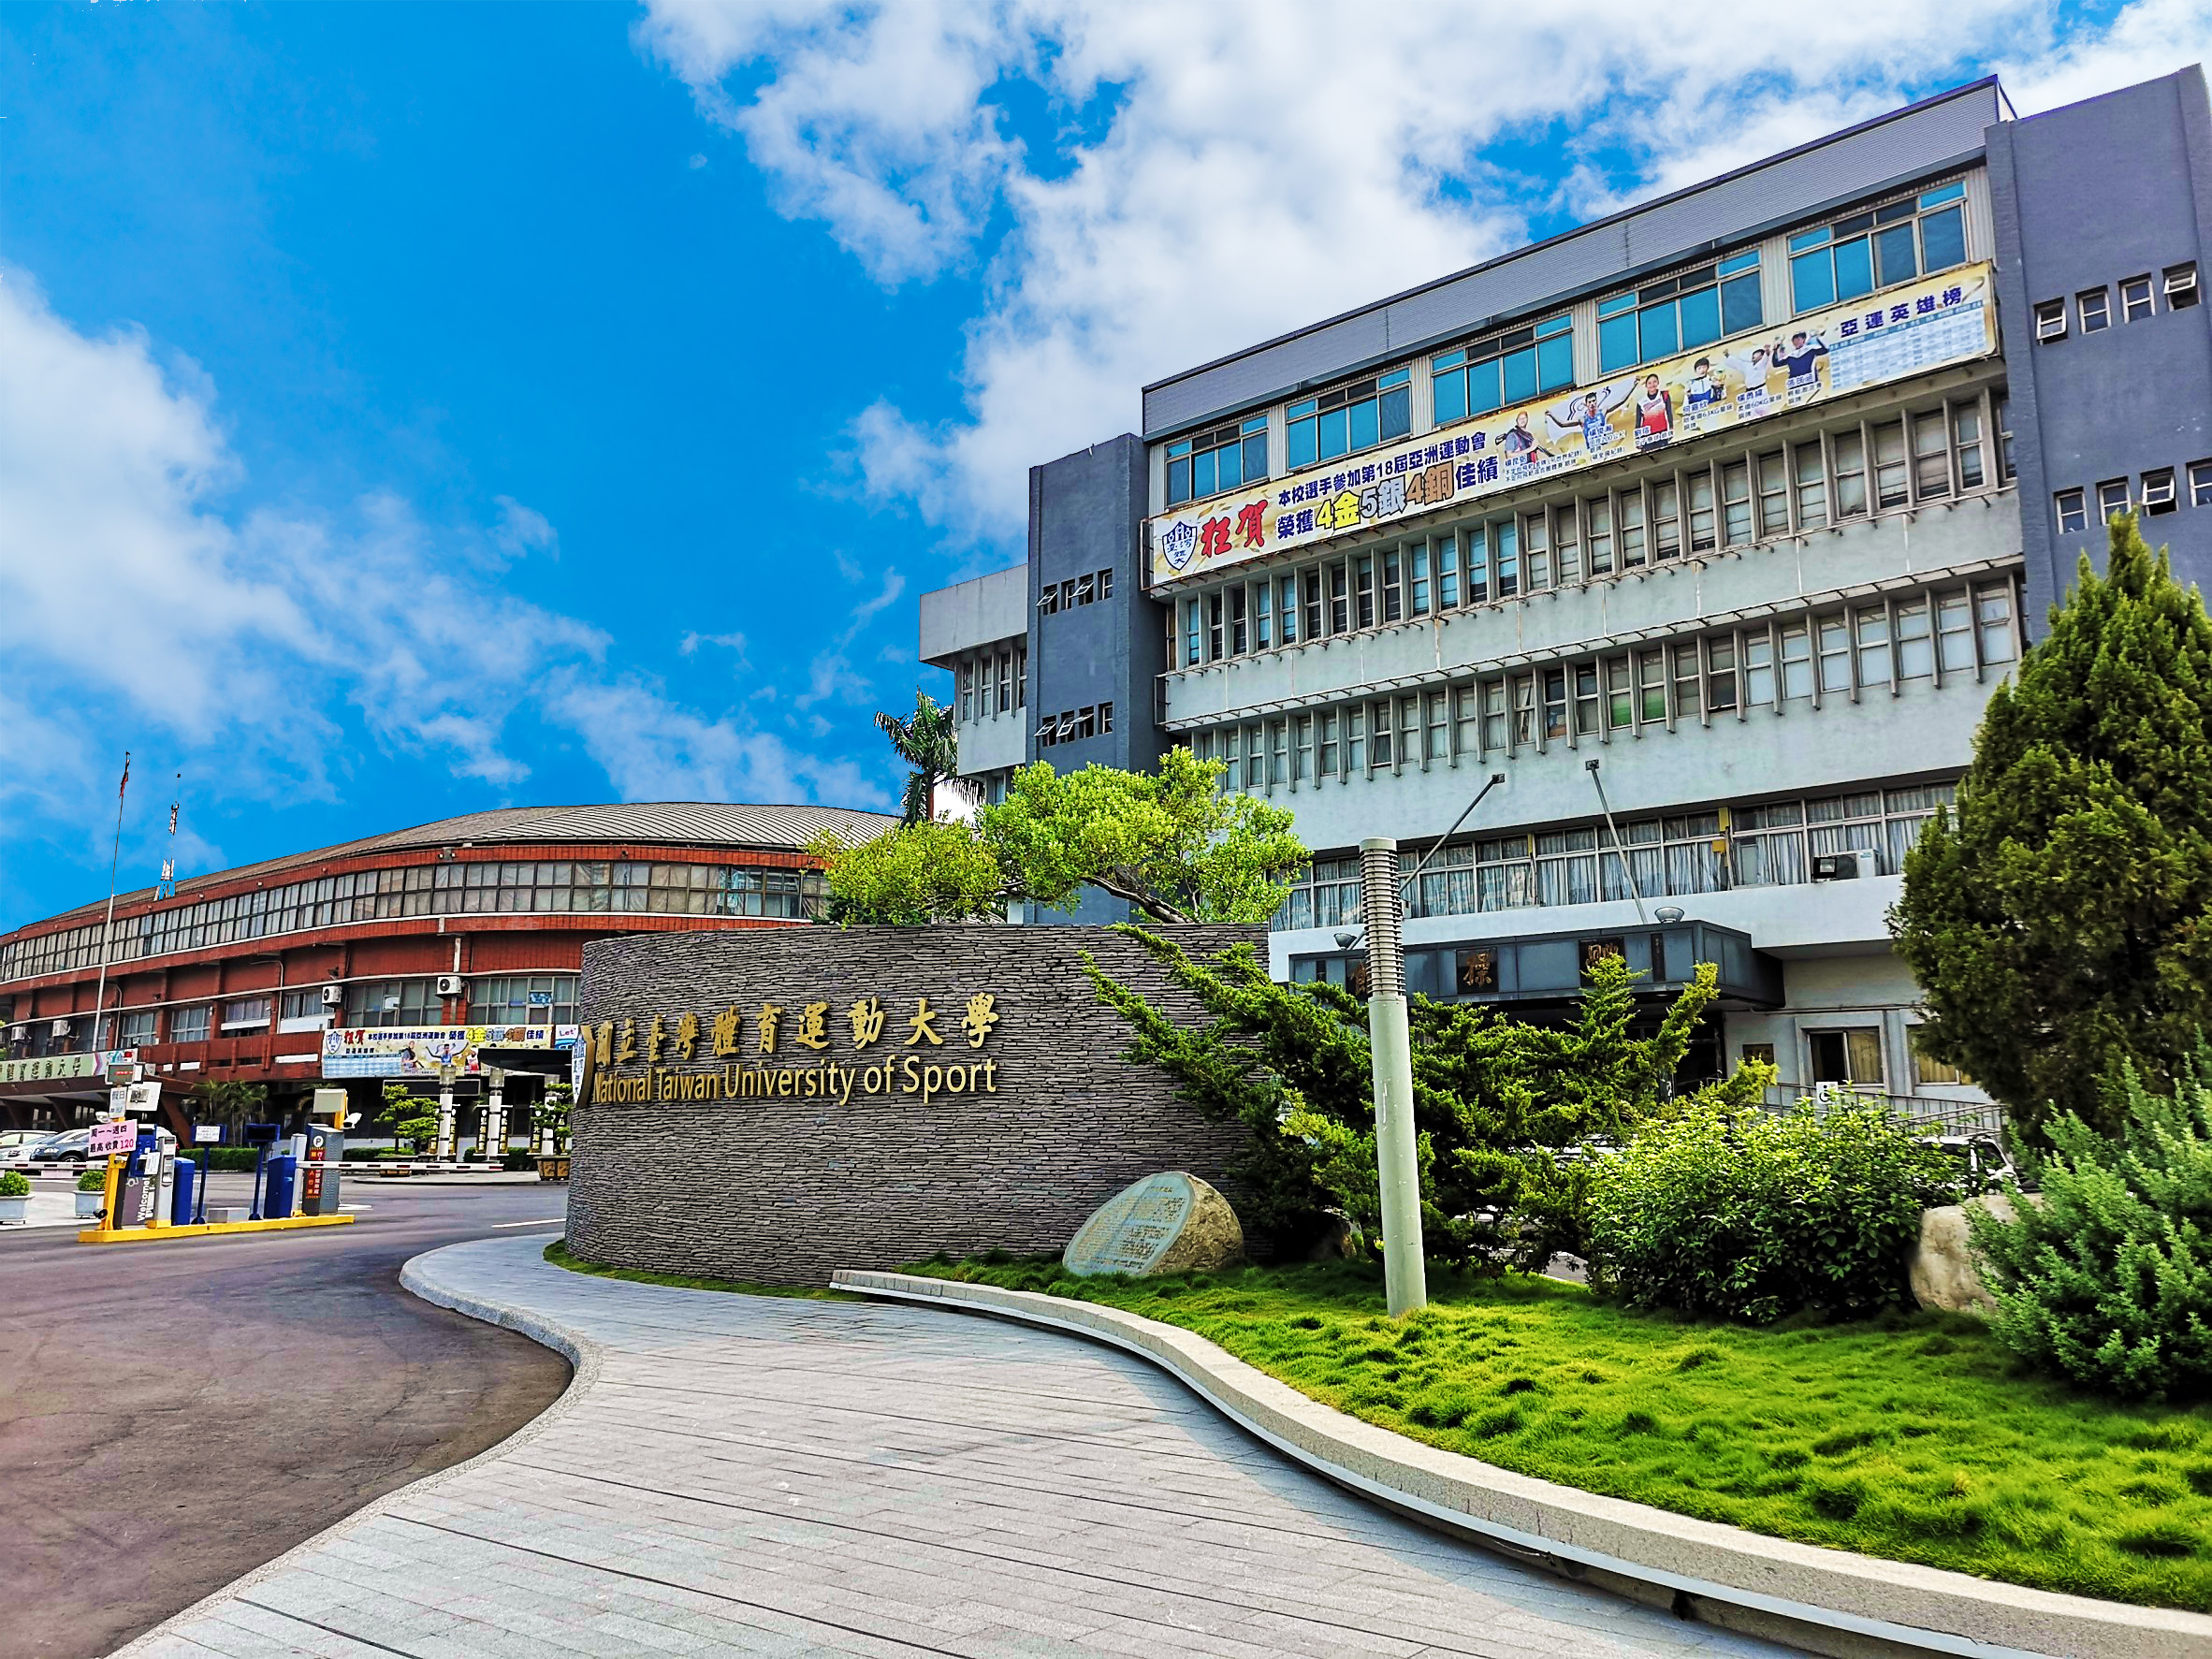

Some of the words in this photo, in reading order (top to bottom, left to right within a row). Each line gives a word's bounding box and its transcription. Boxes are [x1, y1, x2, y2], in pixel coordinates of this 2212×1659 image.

[1841, 286, 1961, 338] 亞運英雄榜
[1277, 456, 1498, 540] 榮獲4金5銀4銅佳績
[1278, 431, 1486, 506] 本校選手參加第18屆亞洲運動會
[595, 992, 999, 1067] 國立臺灣體育運動大學
[593, 1069, 653, 1103] National
[657, 1065, 720, 1100] Taiwan
[724, 1058, 856, 1106] University
[864, 1055, 897, 1094] of
[902, 1055, 997, 1104] Sport
